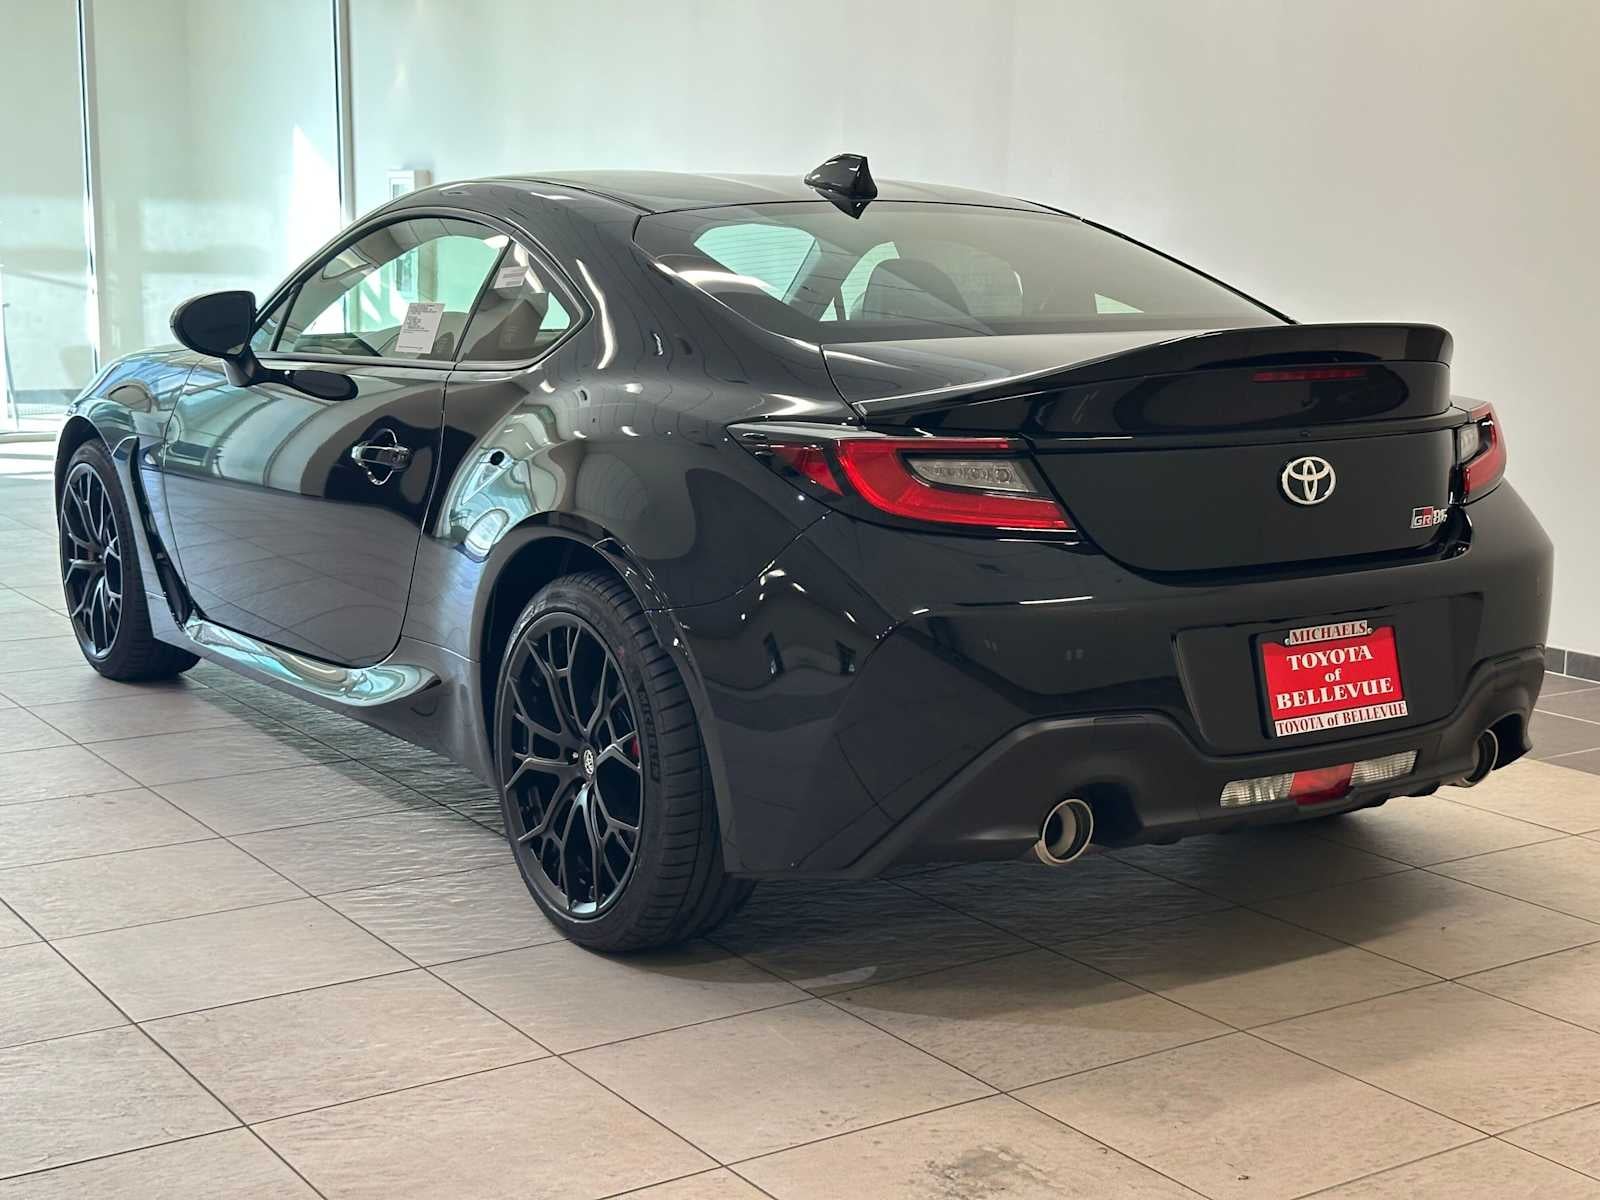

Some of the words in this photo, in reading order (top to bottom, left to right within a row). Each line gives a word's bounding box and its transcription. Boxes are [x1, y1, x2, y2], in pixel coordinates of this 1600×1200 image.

[1291, 622, 1366, 643] MICHAELS
[1286, 645, 1373, 671] TOYOTA
[1324, 668, 1342, 683] of
[1276, 677, 1393, 710] BELLEVUE
[1277, 719, 1324, 735] TOYOTA
[1327, 715, 1341, 727] of
[1343, 702, 1407, 724] BELLEVUE
